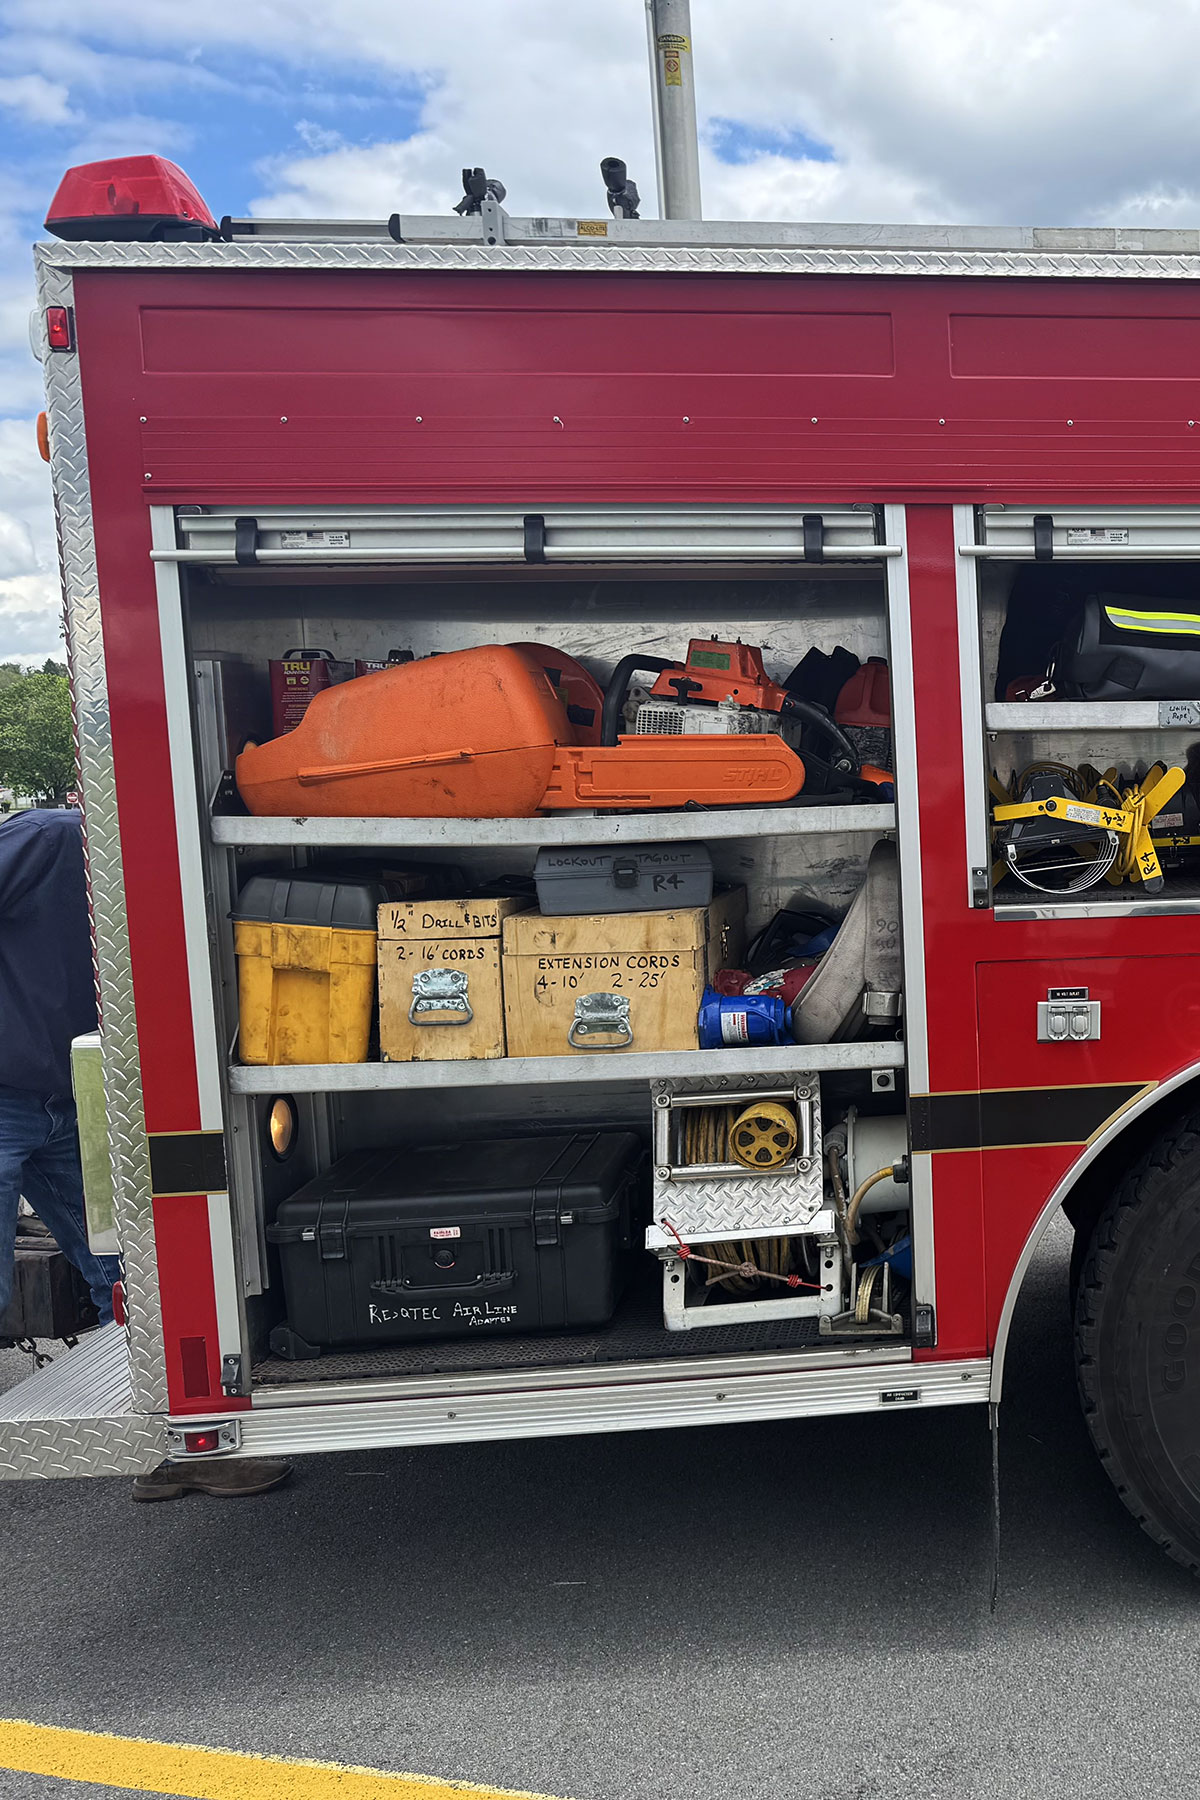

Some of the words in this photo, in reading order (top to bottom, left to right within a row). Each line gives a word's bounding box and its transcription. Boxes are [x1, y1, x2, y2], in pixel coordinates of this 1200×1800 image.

[281, 662, 310, 670] TRU
[1172, 712, 1188, 721] Rope
[723, 768, 782, 782] STIHL
[548, 855, 611, 867] LOCKOUT
[635, 853, 691, 864] TAGOUT
[652, 874, 685, 893] R4
[472, 914, 498, 928] BITS
[442, 947, 485, 960] CORDS
[538, 956, 620, 970] EXTENSION
[626, 955, 680, 968] CORDS
